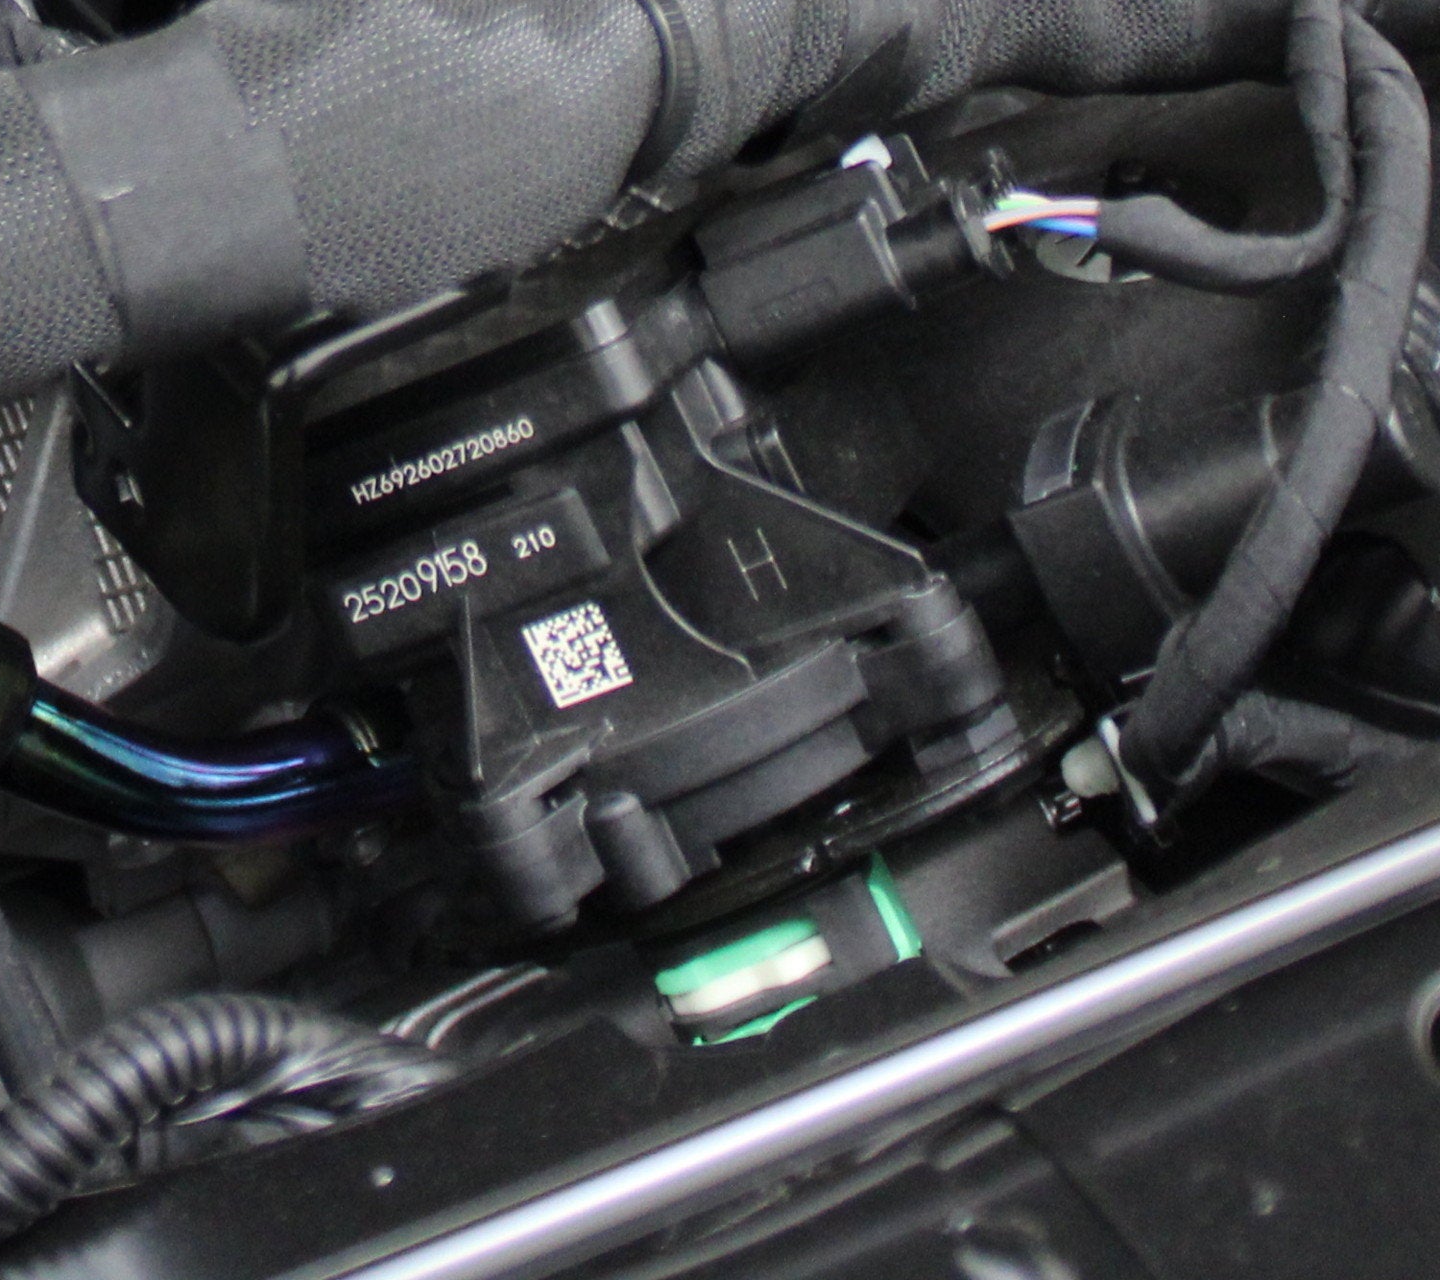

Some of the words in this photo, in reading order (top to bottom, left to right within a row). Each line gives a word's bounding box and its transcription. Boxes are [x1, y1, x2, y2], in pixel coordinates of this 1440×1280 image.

[351, 415, 535, 507] HZ692602720860
[342, 540, 488, 625] 25209158
[511, 524, 557, 561] 210
